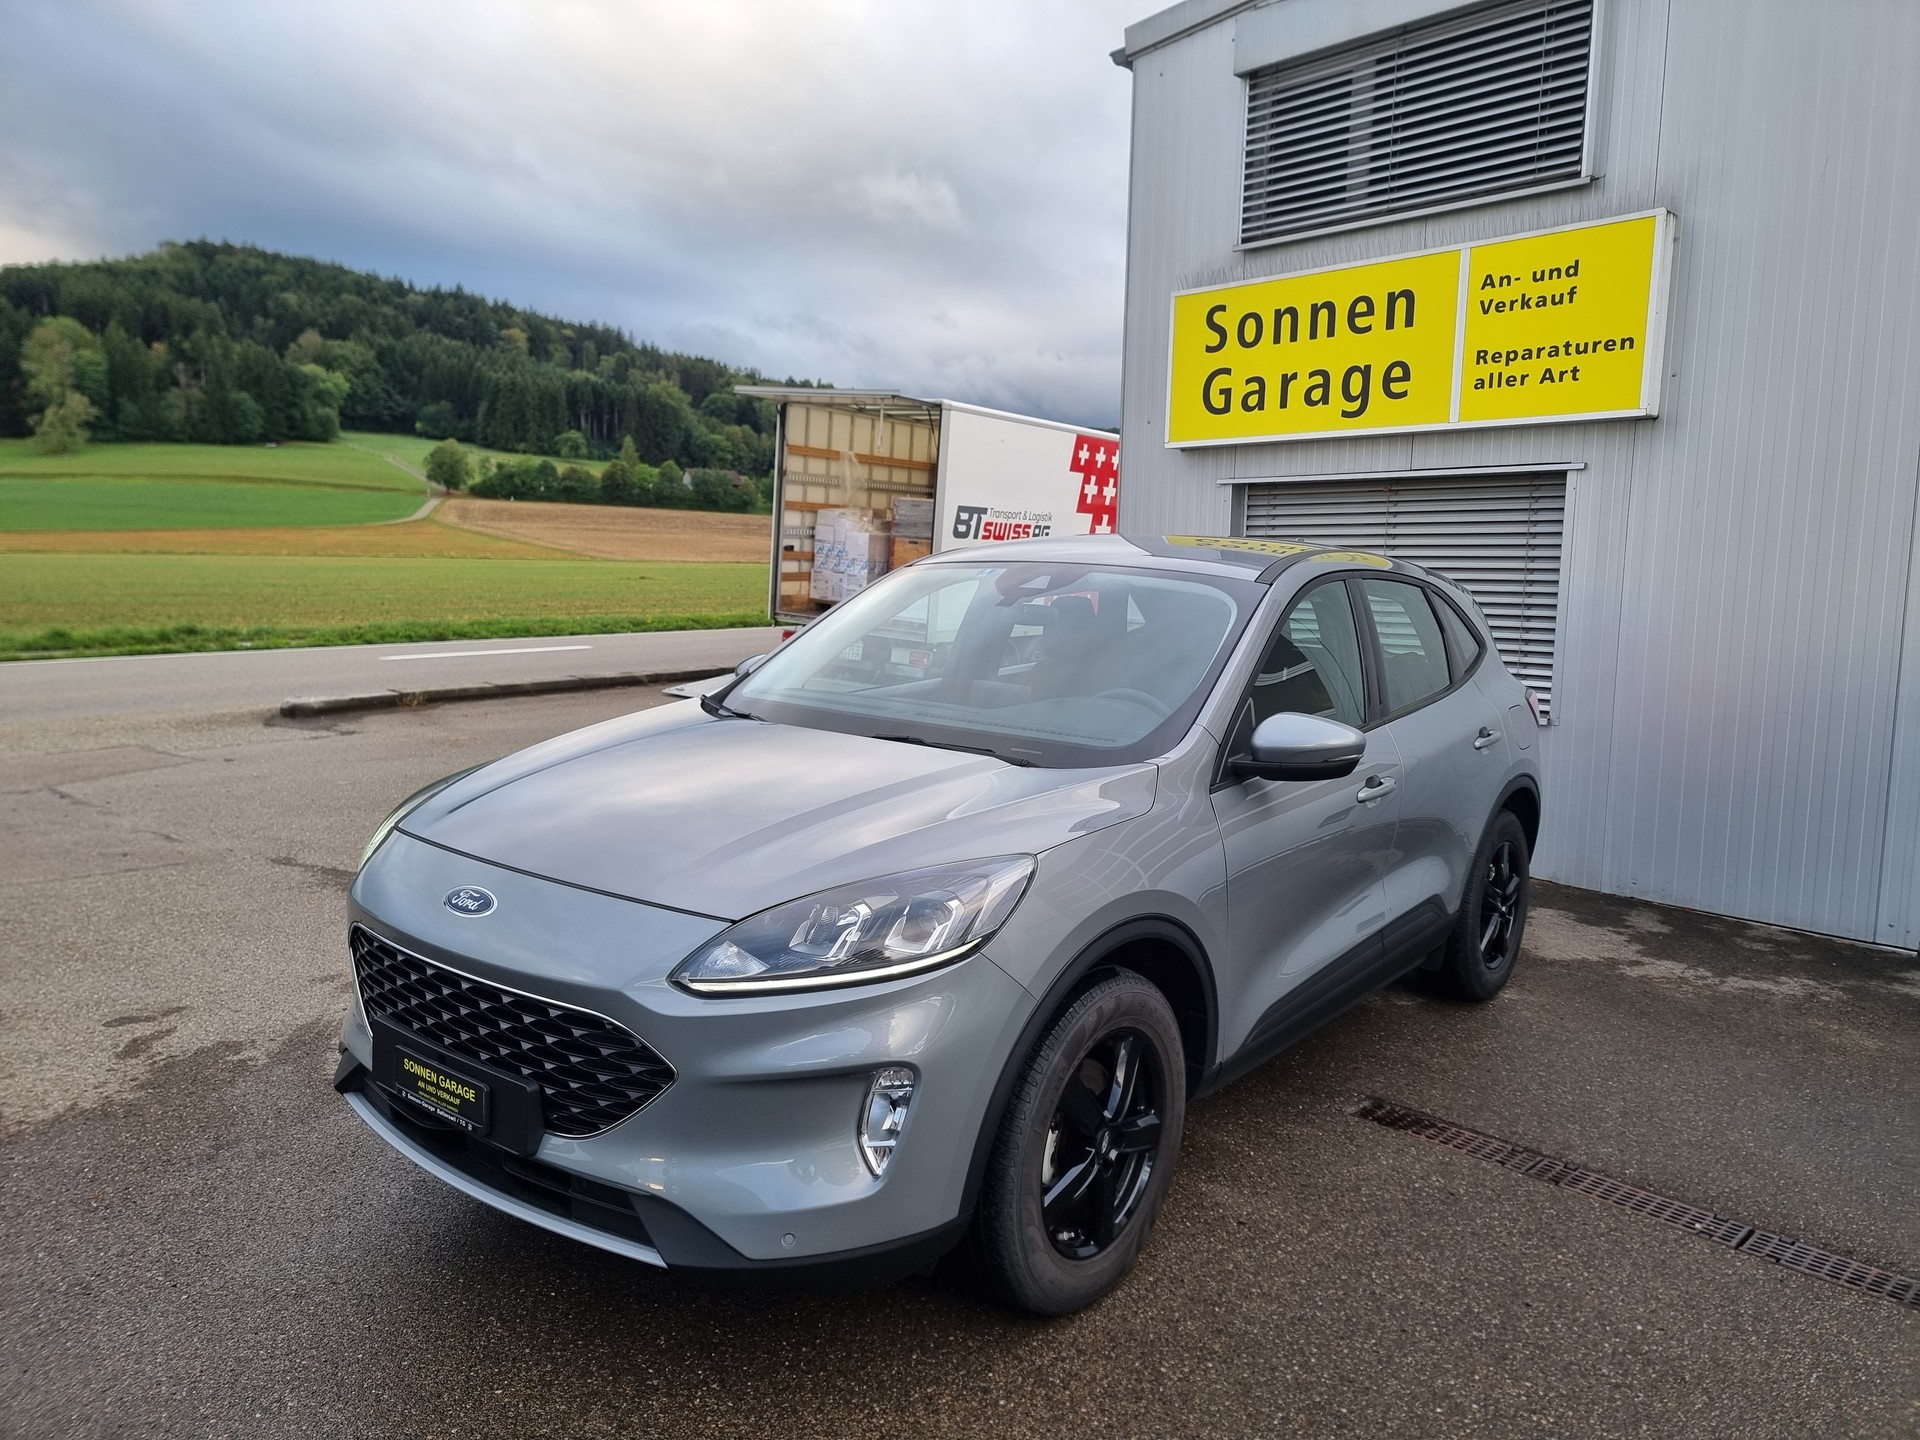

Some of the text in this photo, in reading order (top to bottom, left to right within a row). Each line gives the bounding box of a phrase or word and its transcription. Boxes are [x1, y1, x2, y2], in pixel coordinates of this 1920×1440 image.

[1480, 259, 1580, 291] An- und
[1480, 286, 1578, 316] Verkauf
[1204, 286, 1416, 354] Sonnen
[1475, 336, 1636, 367] Reparaturen
[1202, 360, 1412, 419] Garage
[1473, 366, 1581, 391] aller Art
[953, 505, 988, 540] BT
[989, 508, 1053, 524] Transport & Logistik
[451, 889, 485, 910] Ford
[403, 1058, 476, 1102] SONNEN GARAGE
[418, 1080, 461, 1105] AN UND VERKAUF
